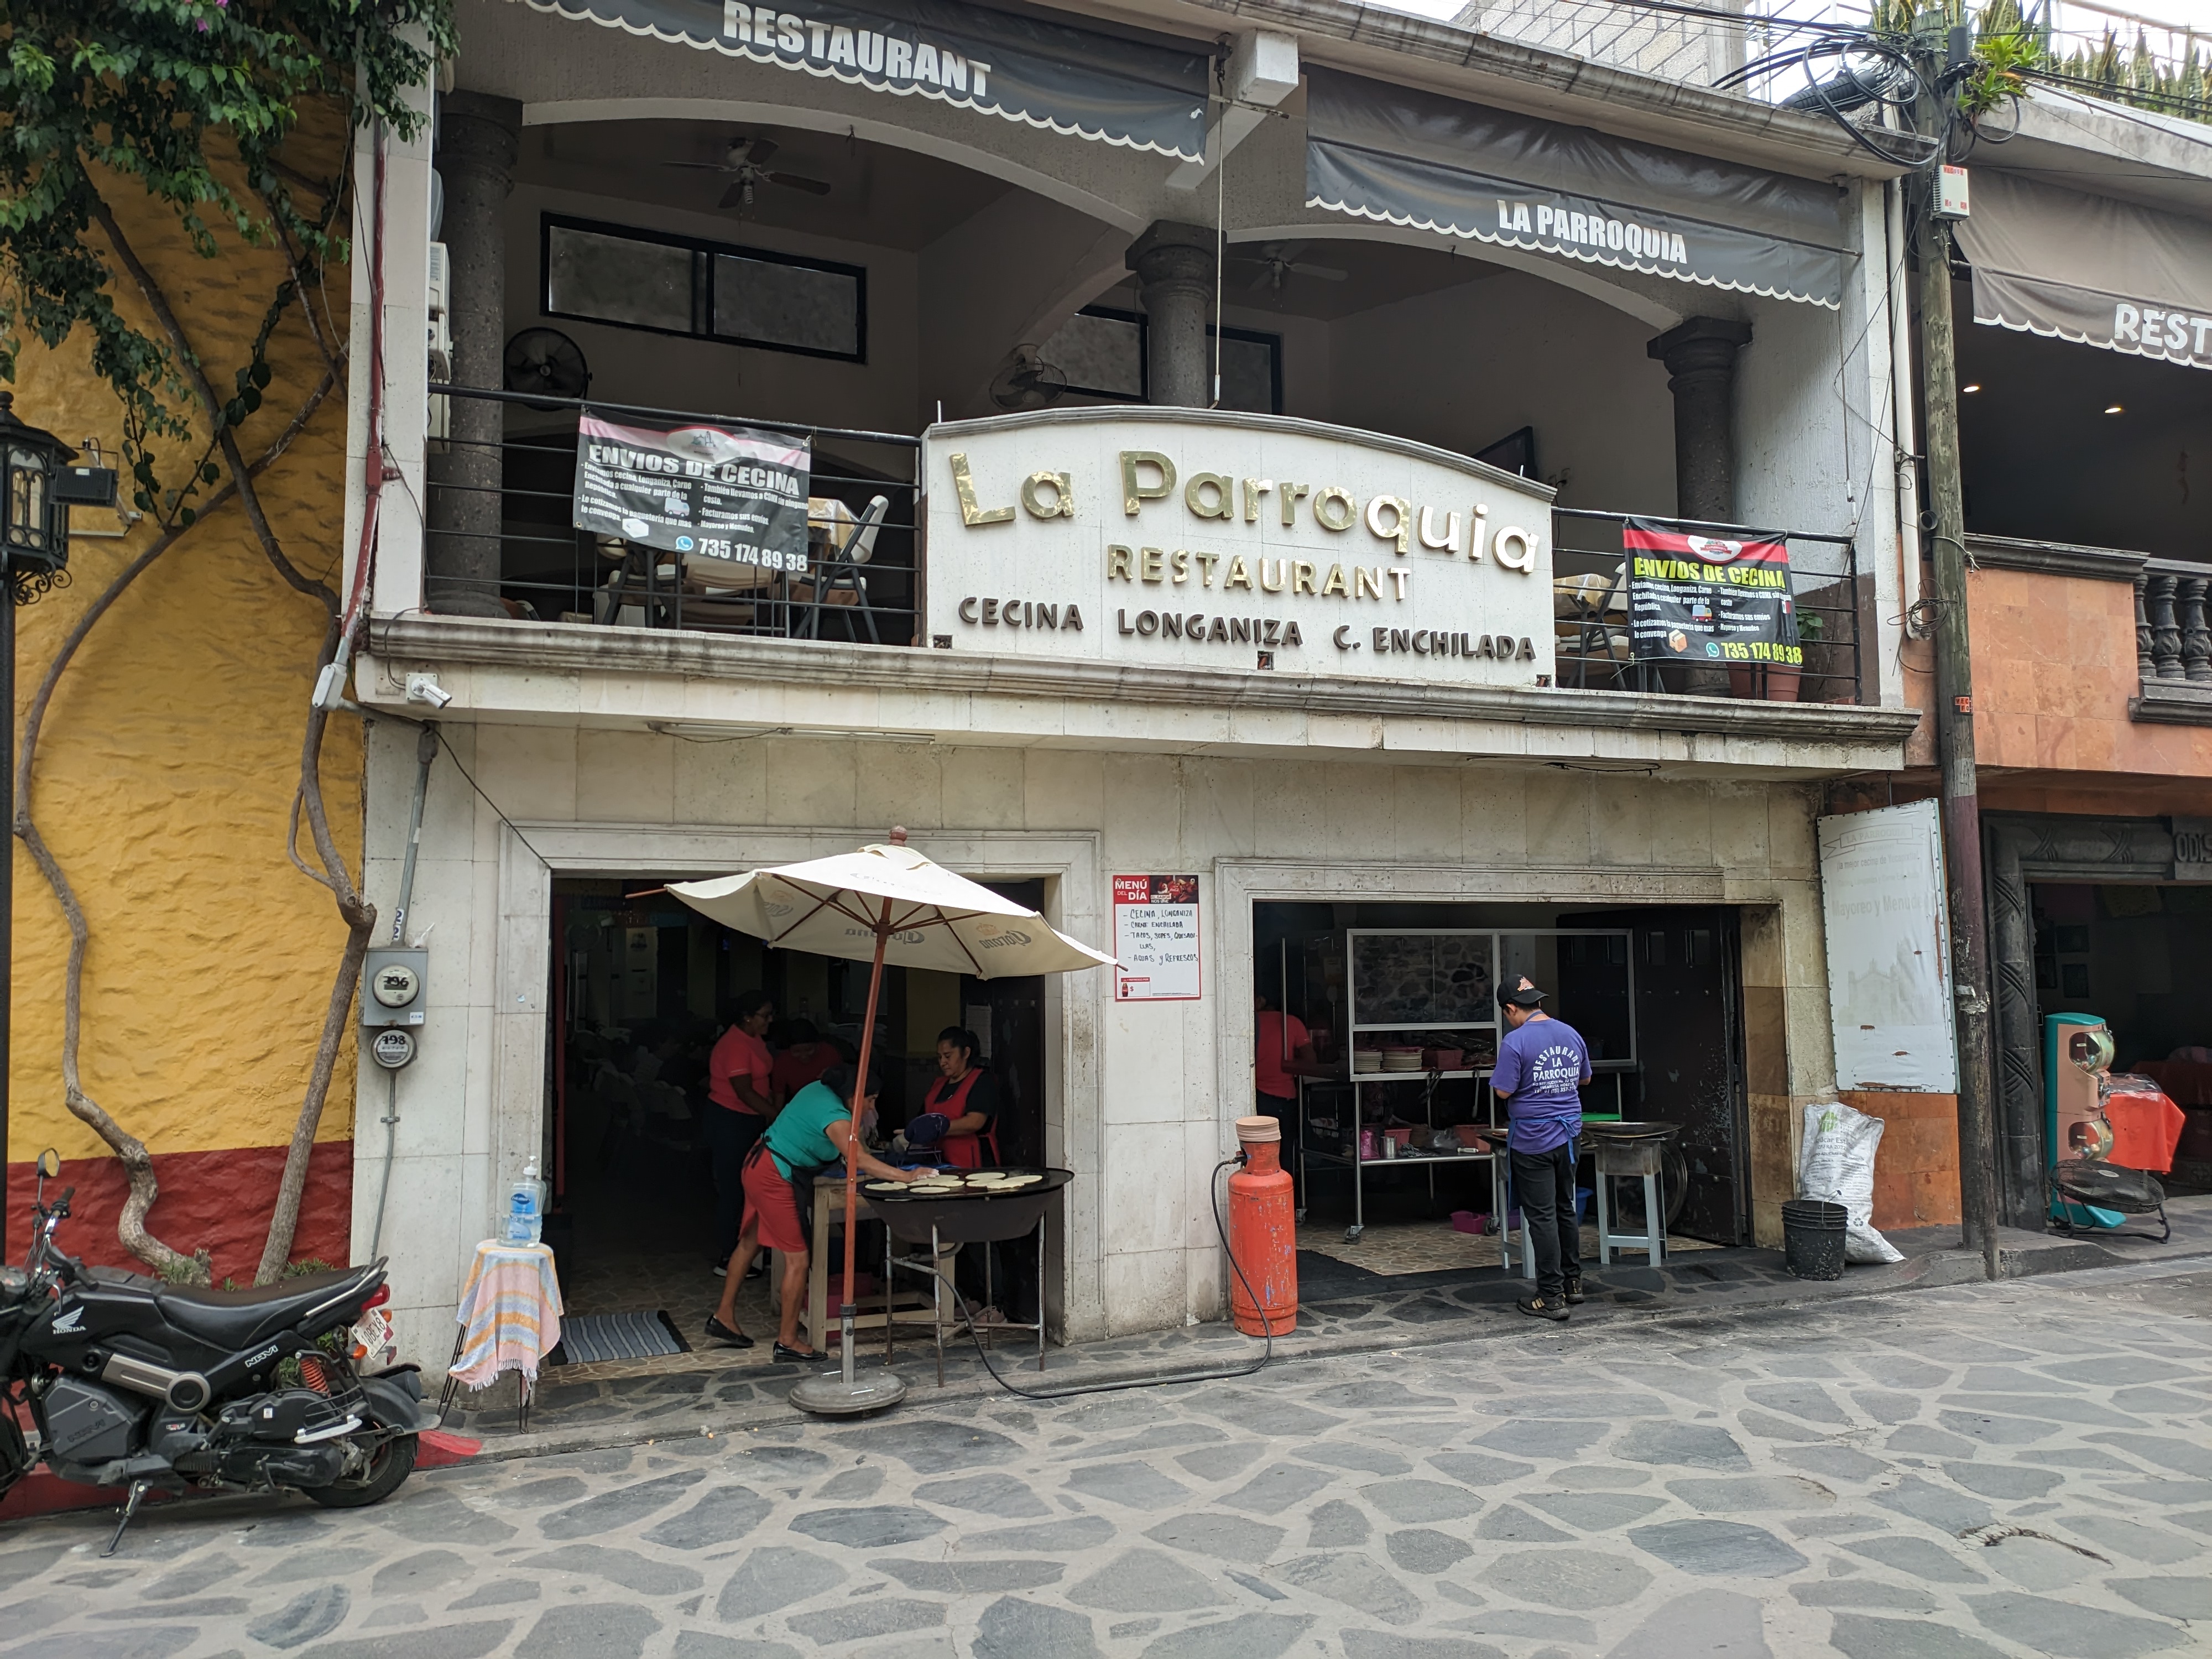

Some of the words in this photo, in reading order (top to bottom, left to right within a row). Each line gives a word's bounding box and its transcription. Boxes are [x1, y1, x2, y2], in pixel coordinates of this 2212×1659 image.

[724, 1, 990, 96] RESTAURANT
[1497, 200, 1531, 233] LA
[1537, 205, 1687, 264] PARROQUIA
[2115, 304, 2212, 354] REST
[585, 462, 613, 478] Enviamos
[673, 479, 691, 489] Carne
[589, 445, 679, 473] ENVIOS
[685, 460, 716, 479] DE
[721, 464, 799, 495] CECINA
[620, 482, 651, 494] cualquier
[654, 488, 670, 498] parte
[672, 491, 680, 499] de
[681, 492, 687, 500] la
[731, 488, 758, 499] llevamos
[582, 494, 589, 503] Le
[591, 496, 622, 513] cotizamos
[702, 507, 738, 519] Facturamos
[949, 452, 1076, 528] La
[1119, 450, 1539, 575] Parroquia
[698, 538, 731, 559] 735
[735, 544, 758, 565] 174
[761, 549, 782, 569] 89
[786, 554, 807, 571] 38
[1107, 544, 1411, 601] RESTAURANT
[1634, 557, 1700, 581] ENVIOS
[1703, 565, 1726, 582] DE
[1728, 567, 1786, 588] CECINA
[1660, 595, 1681, 604] cualquier
[1698, 586, 1712, 594] Carne
[958, 596, 1083, 630] CECINA
[1118, 608, 1303, 646] LONGANIZA
[1333, 625, 1361, 651] C.
[1373, 627, 1537, 661] ENCHILADA
[1721, 643, 1749, 658] 735
[1750, 643, 1771, 659] 174
[1772, 643, 1785, 661] 89
[1786, 646, 1802, 664] 38
[1860, 829, 1906, 840] PARROQUIA
[1845, 860, 1859, 870] mejor
[1861, 858, 1878, 867] cecina
[1880, 855, 1886, 864] de
[1115, 879, 1147, 889] MENÚ
[1129, 890, 1147, 900] DÍA
[1832, 899, 1872, 920] Mayoreo
[1874, 900, 1880, 917] y
[1165, 953, 1198, 962] REFRESCOS
[1533, 1046, 1579, 1071] RESTAURANT
[1552, 1057, 1563, 1067] LA
[1533, 1067, 1579, 1081] PARROQUIA
[245, 1345, 278, 1368] NAVI
